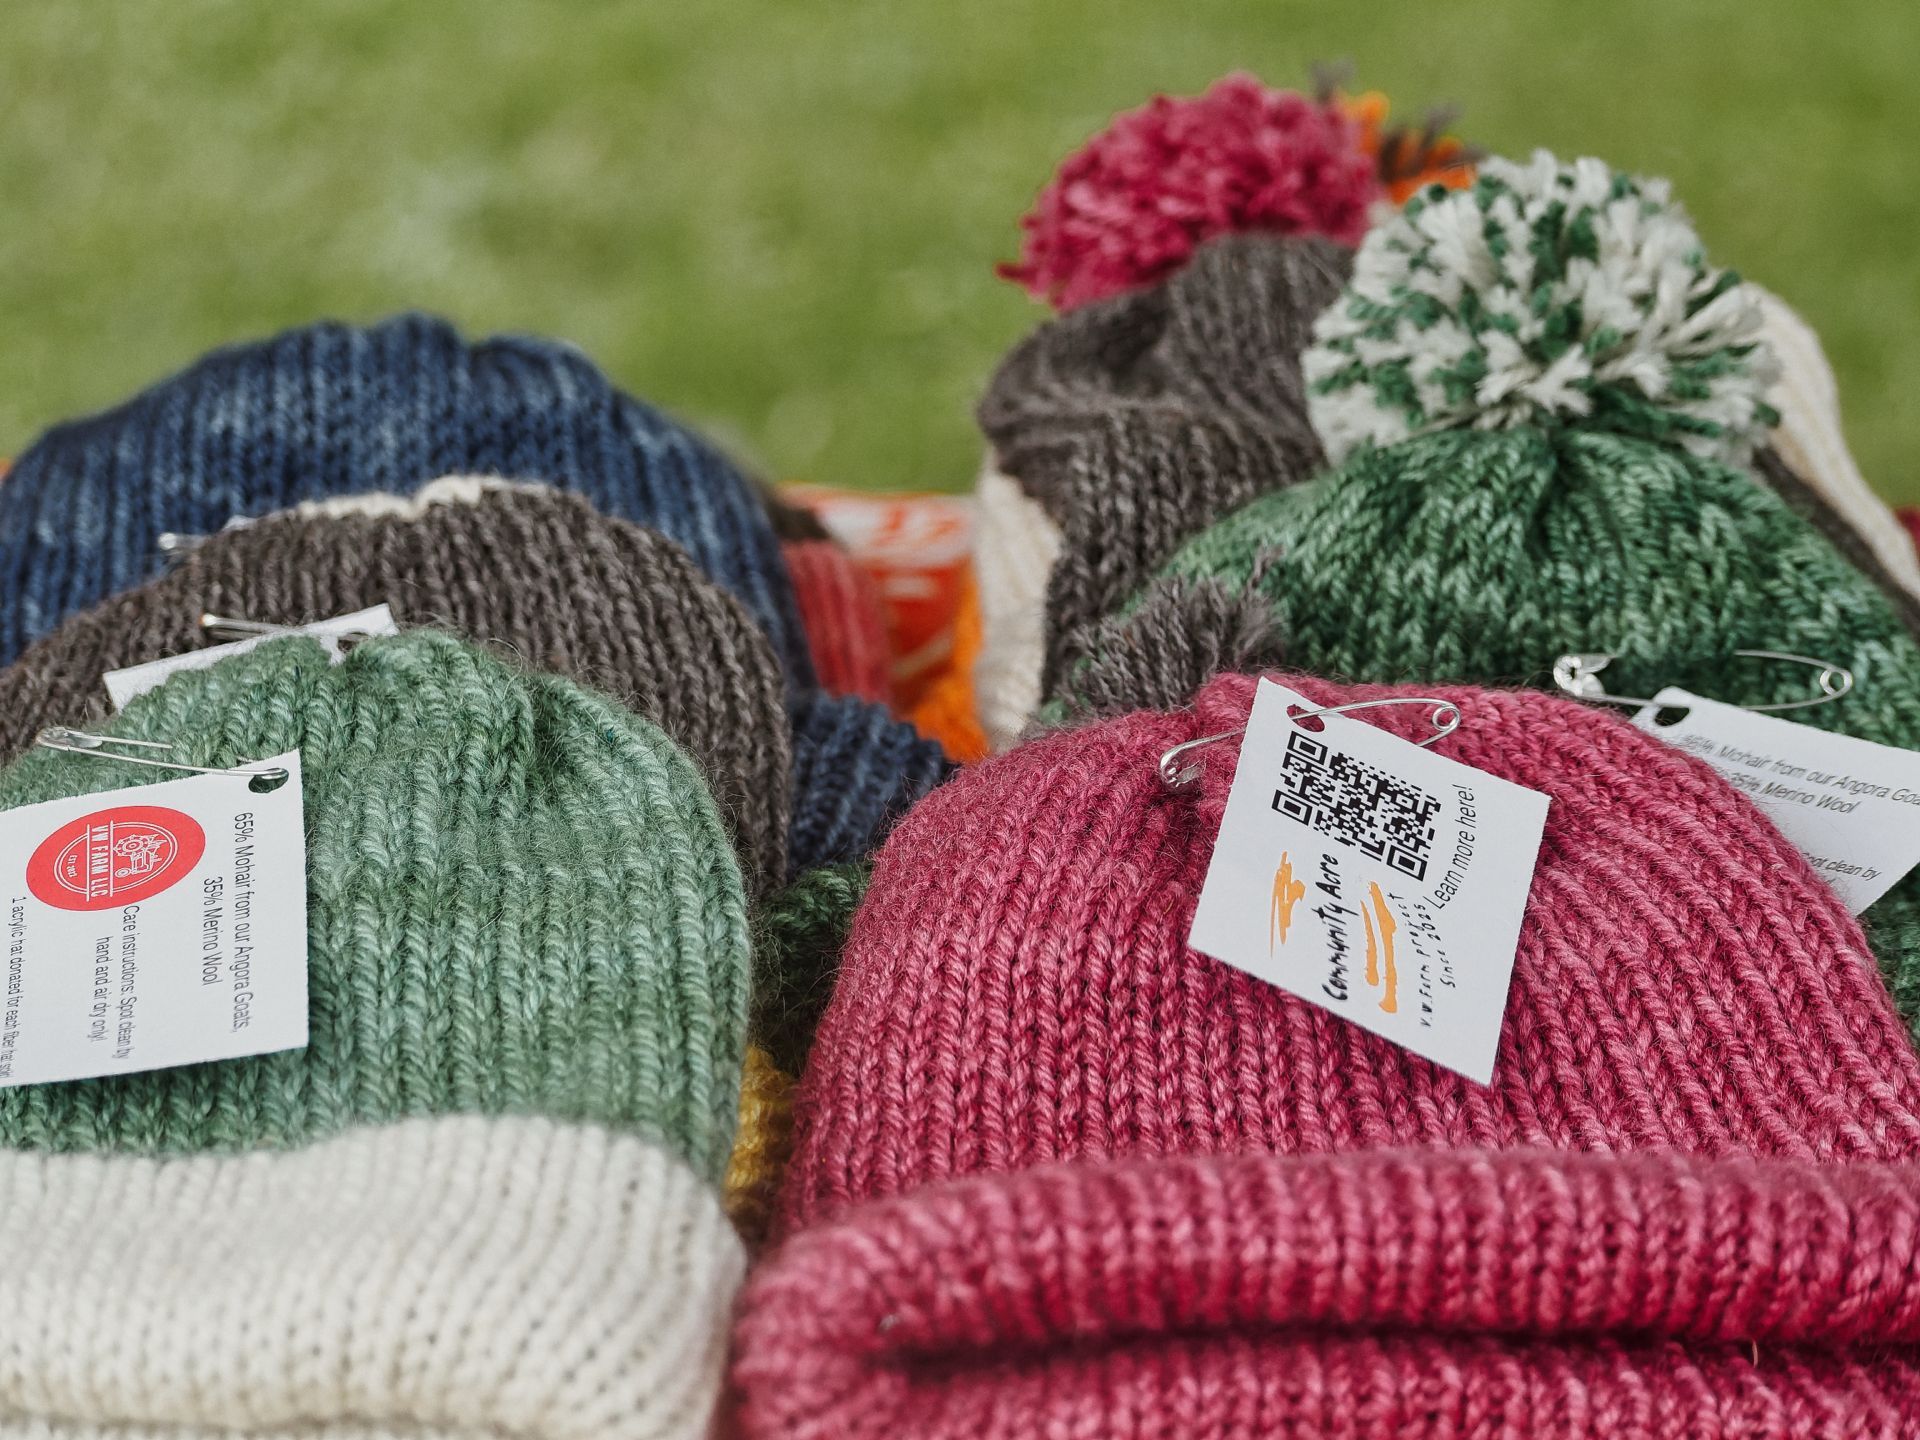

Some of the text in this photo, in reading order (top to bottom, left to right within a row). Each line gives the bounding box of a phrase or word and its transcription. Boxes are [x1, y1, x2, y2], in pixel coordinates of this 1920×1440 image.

[1760, 781, 1815, 804] Merino
[1816, 795, 1862, 813] Wool
[1806, 771, 1836, 784] our
[1831, 775, 1890, 797] Angora
[91, 825, 109, 897] VW FARM LLC
[1423, 784, 1476, 909] Learn more here!
[1825, 860, 1863, 876] clean
[1861, 866, 1882, 881] by
[12, 896, 27, 904] 1
[8, 905, 27, 938] acrylic
[202, 876, 223, 986] 35% Merino Wool
[229, 812, 255, 1034] 65% Mohair from our Angora Goats,
[1311, 853, 1359, 1001] Community Acre
[11, 938, 26, 956] hat
[96, 936, 113, 963] hand
[8, 959, 25, 995] donated
[95, 966, 112, 986] and
[112, 905, 141, 1060] Care instructions: Spot clean by
[1437, 949, 1456, 988] Since
[7, 995, 23, 1008] for
[94, 988, 112, 1000] air
[3, 1009, 20, 1031] each
[89, 1002, 111, 1018] dry
